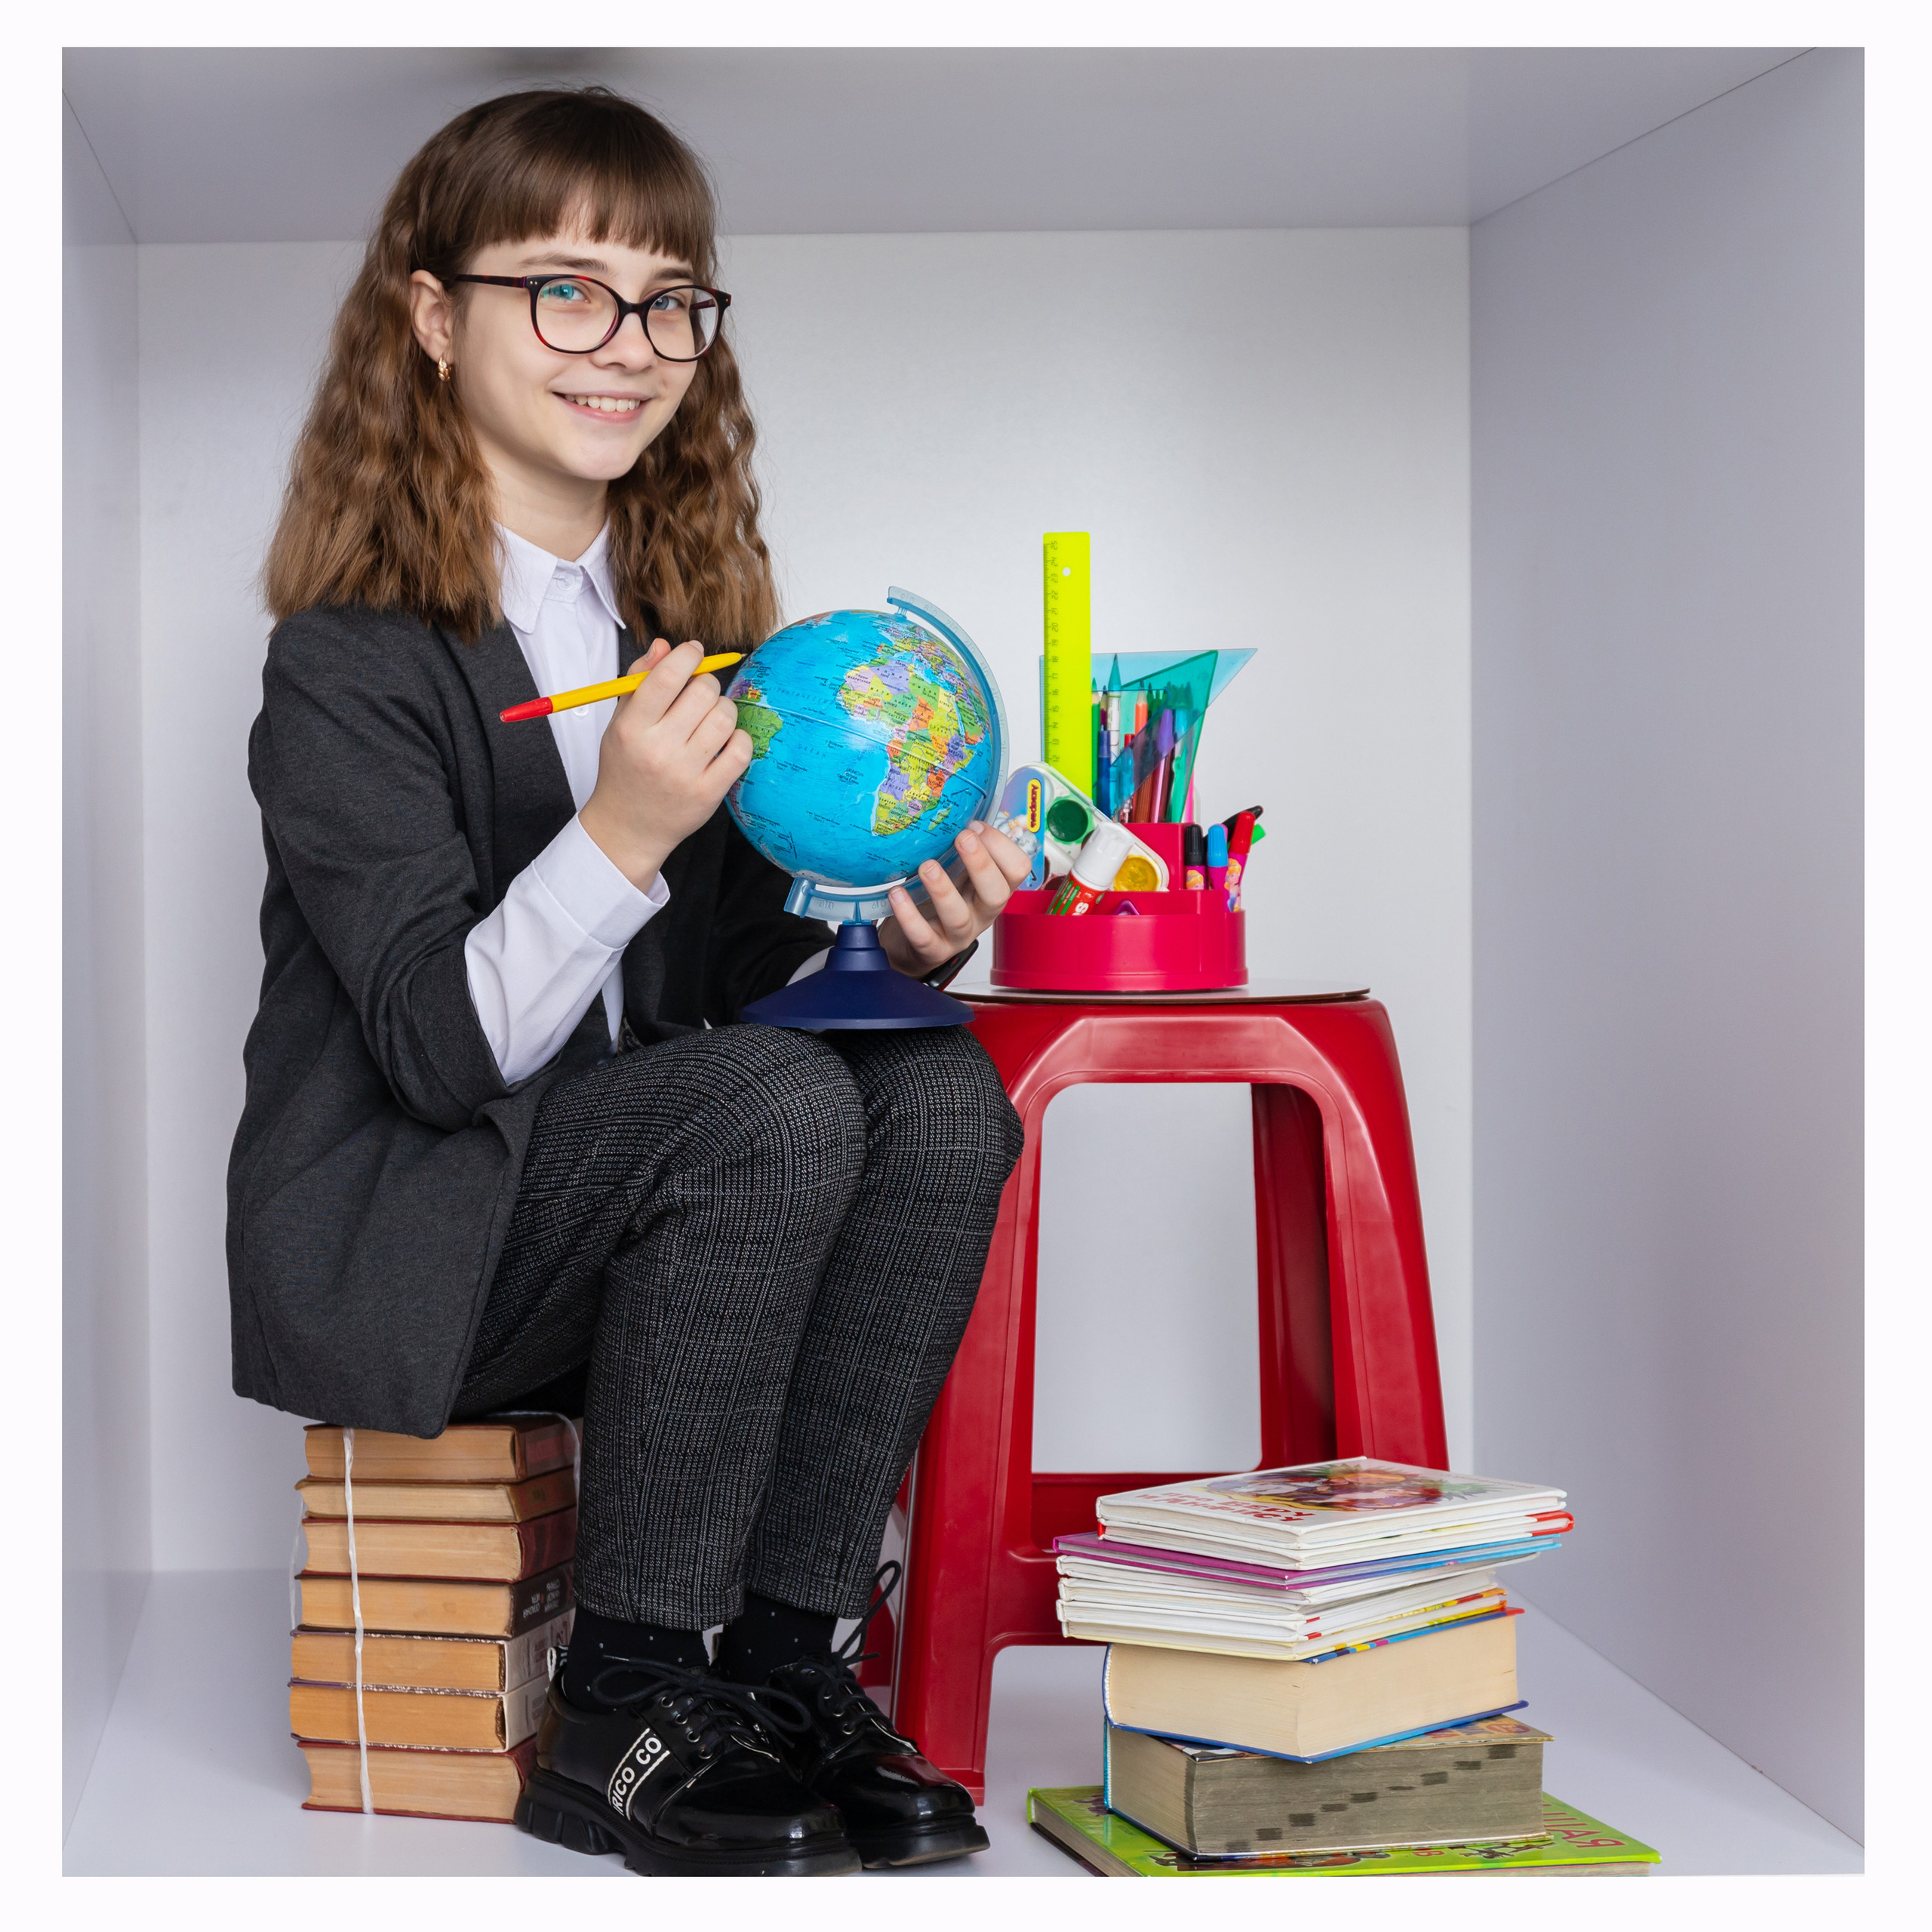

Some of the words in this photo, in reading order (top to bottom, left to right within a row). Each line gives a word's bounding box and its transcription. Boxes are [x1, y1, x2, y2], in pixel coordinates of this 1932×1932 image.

[1051, 540, 1058, 549] 25
[1051, 557, 1058, 567] 24
[1051, 574, 1058, 583] 23
[1051, 590, 1058, 600] 22
[1052, 623, 1058, 632] 20
[877, 668, 909, 681] АЛЖИР
[798, 745, 826, 757] ОКЕАН
[885, 782, 903, 792] АНГОЛА
[635, 1737, 661, 1764] CO
